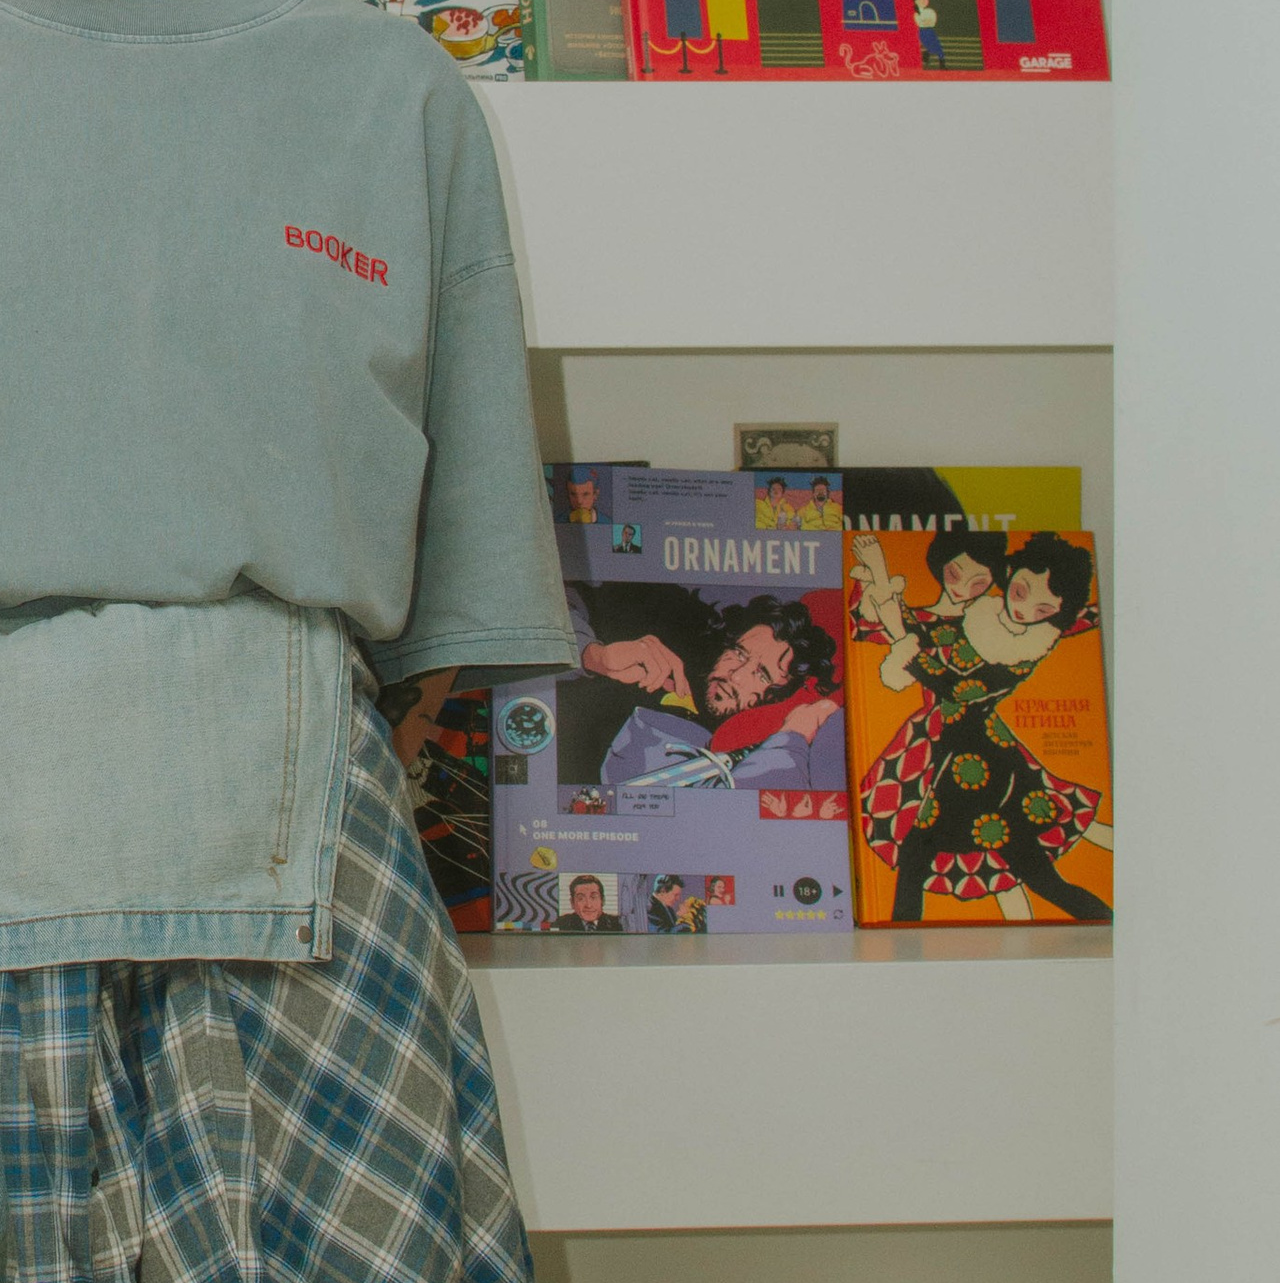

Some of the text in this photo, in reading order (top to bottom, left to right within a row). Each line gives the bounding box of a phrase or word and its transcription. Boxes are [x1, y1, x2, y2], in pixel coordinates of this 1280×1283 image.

[1020, 55, 1072, 68] GARAGE
[284, 225, 389, 287] BOOKER
[664, 535, 821, 575] ORNAMENT
[1014, 699, 1090, 713] КРАСНАЯ
[1014, 715, 1077, 729] ПТИЦА
[532, 831, 640, 842] ONE MORE EPISODE
[799, 886, 817, 897] 18+
